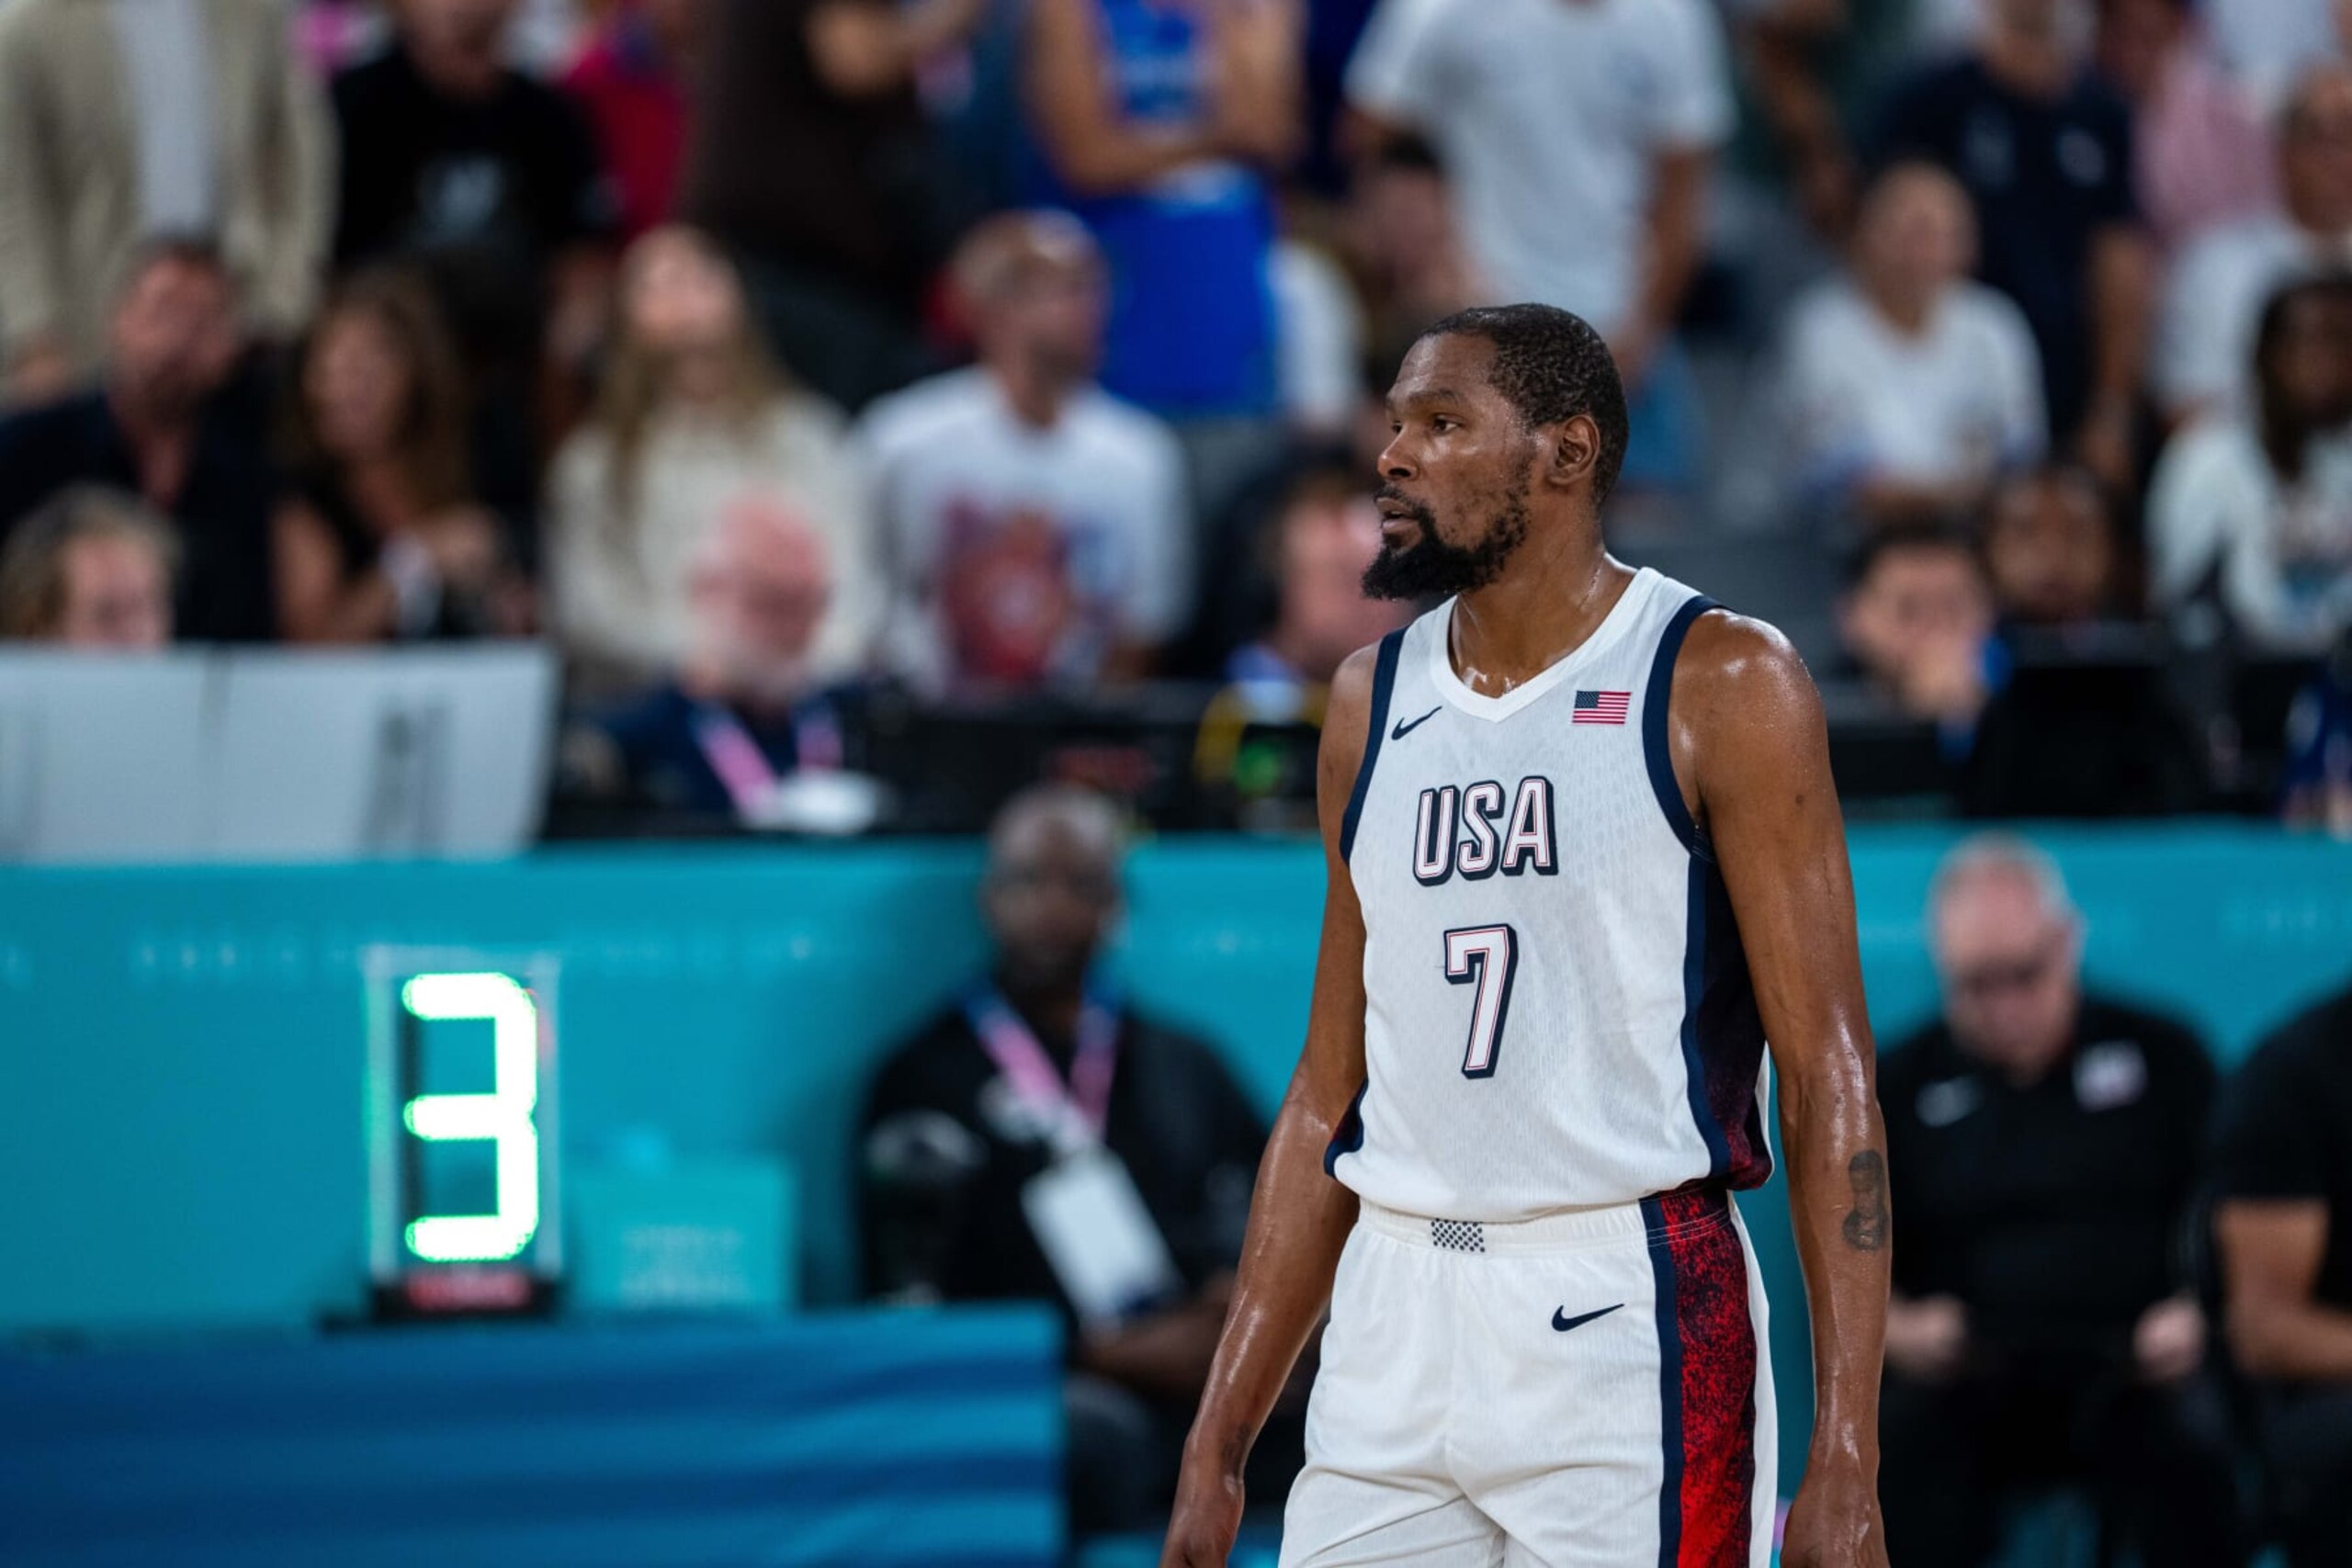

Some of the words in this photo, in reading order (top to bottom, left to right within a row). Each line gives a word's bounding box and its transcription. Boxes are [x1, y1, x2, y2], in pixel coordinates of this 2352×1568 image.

[1414, 776, 1558, 886] USA
[1443, 923, 1518, 1079] 7
[402, 972, 538, 1262] 3
